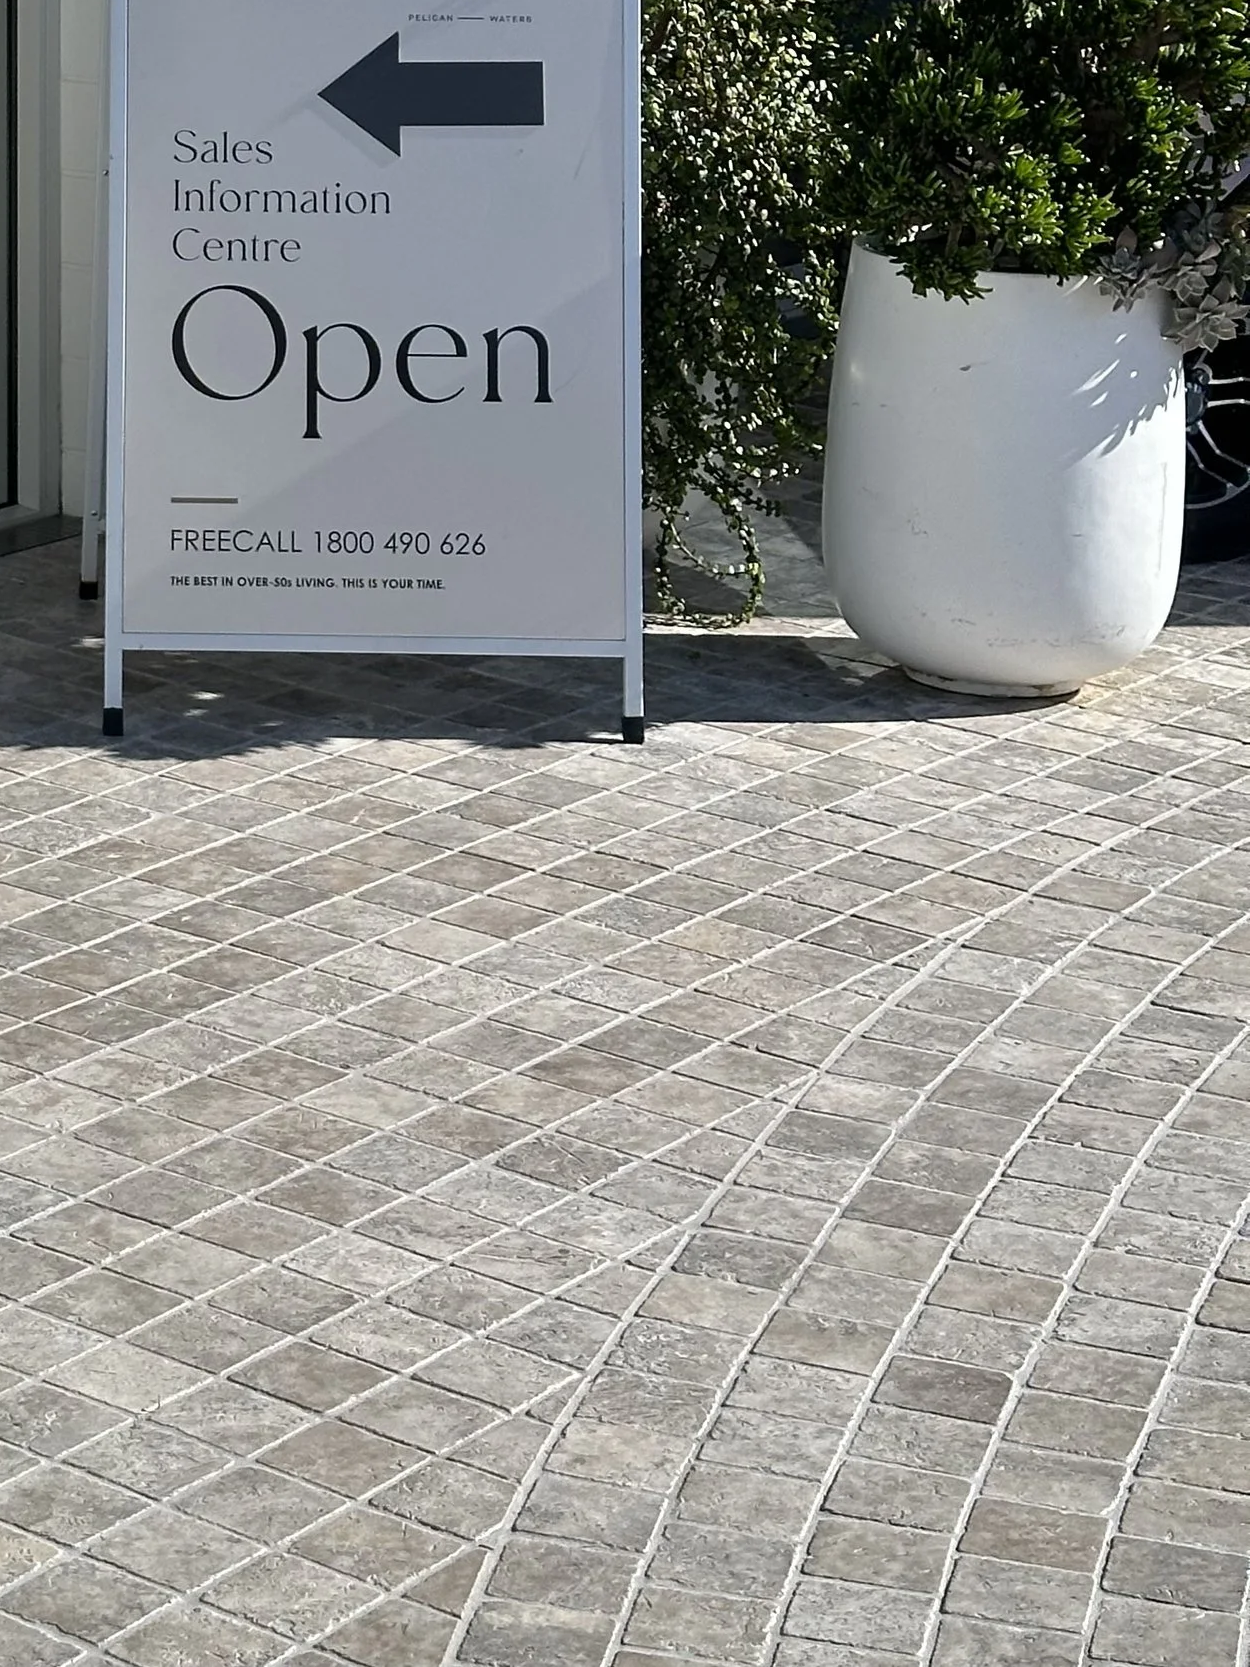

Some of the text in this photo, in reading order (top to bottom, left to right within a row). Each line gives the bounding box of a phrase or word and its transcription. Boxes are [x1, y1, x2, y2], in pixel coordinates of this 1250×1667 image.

[408, 14, 532, 23] PELICAN WATERS
[173, 129, 273, 164] Sales
[174, 179, 391, 214] Information
[172, 228, 301, 262] Centre
[171, 284, 553, 439] Open
[170, 529, 486, 555] FREECALL 1800 490 626
[170, 575, 190, 586] THE
[193, 576, 218, 586] BEST
[221, 576, 233, 586] IN
[296, 577, 337, 588] LIVING.
[342, 578, 365, 588] THIS
[369, 578, 378, 588] IS
[382, 579, 413, 589] YOUR
